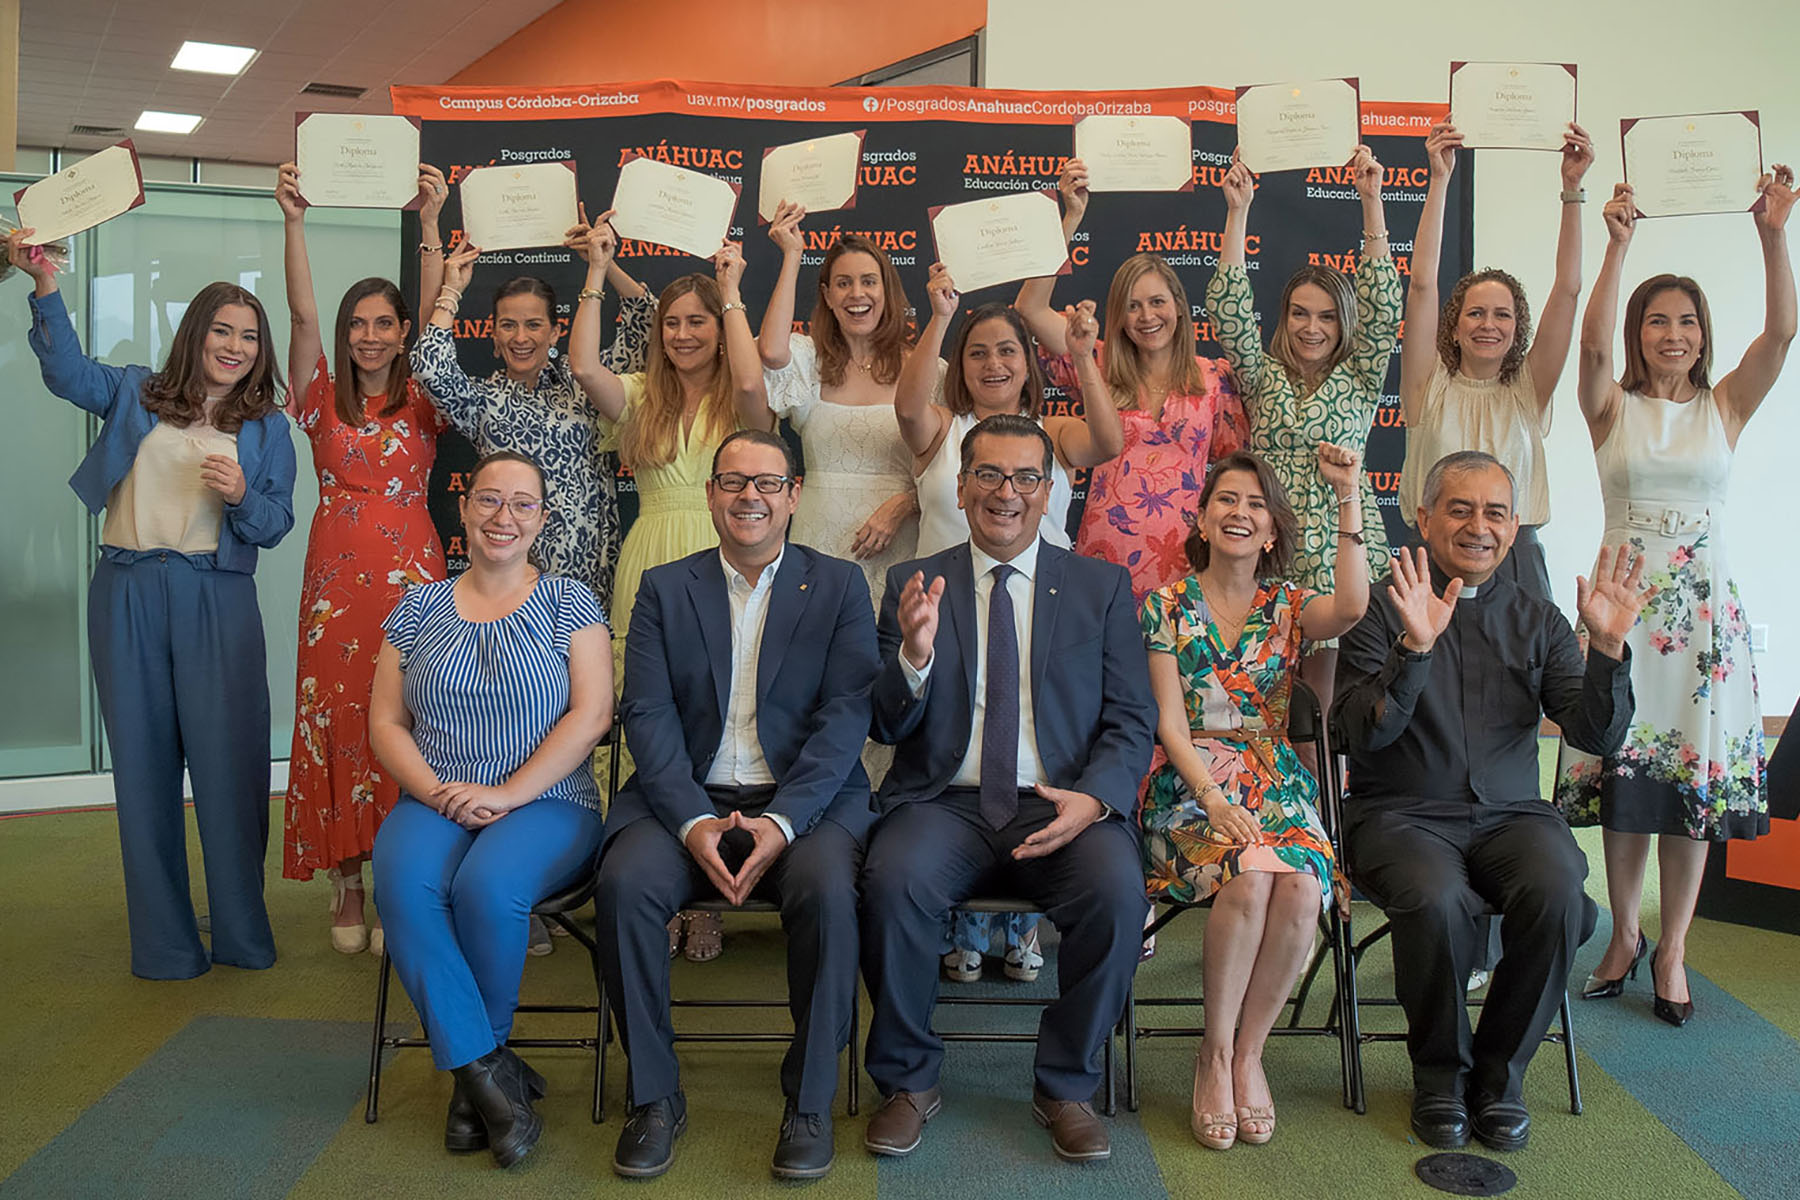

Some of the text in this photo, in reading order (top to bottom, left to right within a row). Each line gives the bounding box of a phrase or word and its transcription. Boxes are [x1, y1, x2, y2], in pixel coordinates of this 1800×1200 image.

[439, 92, 639, 112] Campus Córdoba-Orizaba
[687, 94, 826, 113] uav.mx/posgrados
[1188, 99, 1432, 127] posgra ahuac.mx
[501, 148, 571, 162] Posgrados
[863, 149, 917, 164] sgrados
[963, 149, 1069, 176] ANÁHUA
[1192, 149, 1233, 166] Posgr
[964, 177, 1060, 190] Educación Cont
[1306, 187, 1427, 202] Educaci ontinua
[1136, 224, 1260, 255] ANÁHUC
[474, 252, 571, 264] ación Continua
[1163, 254, 1201, 265] ación
